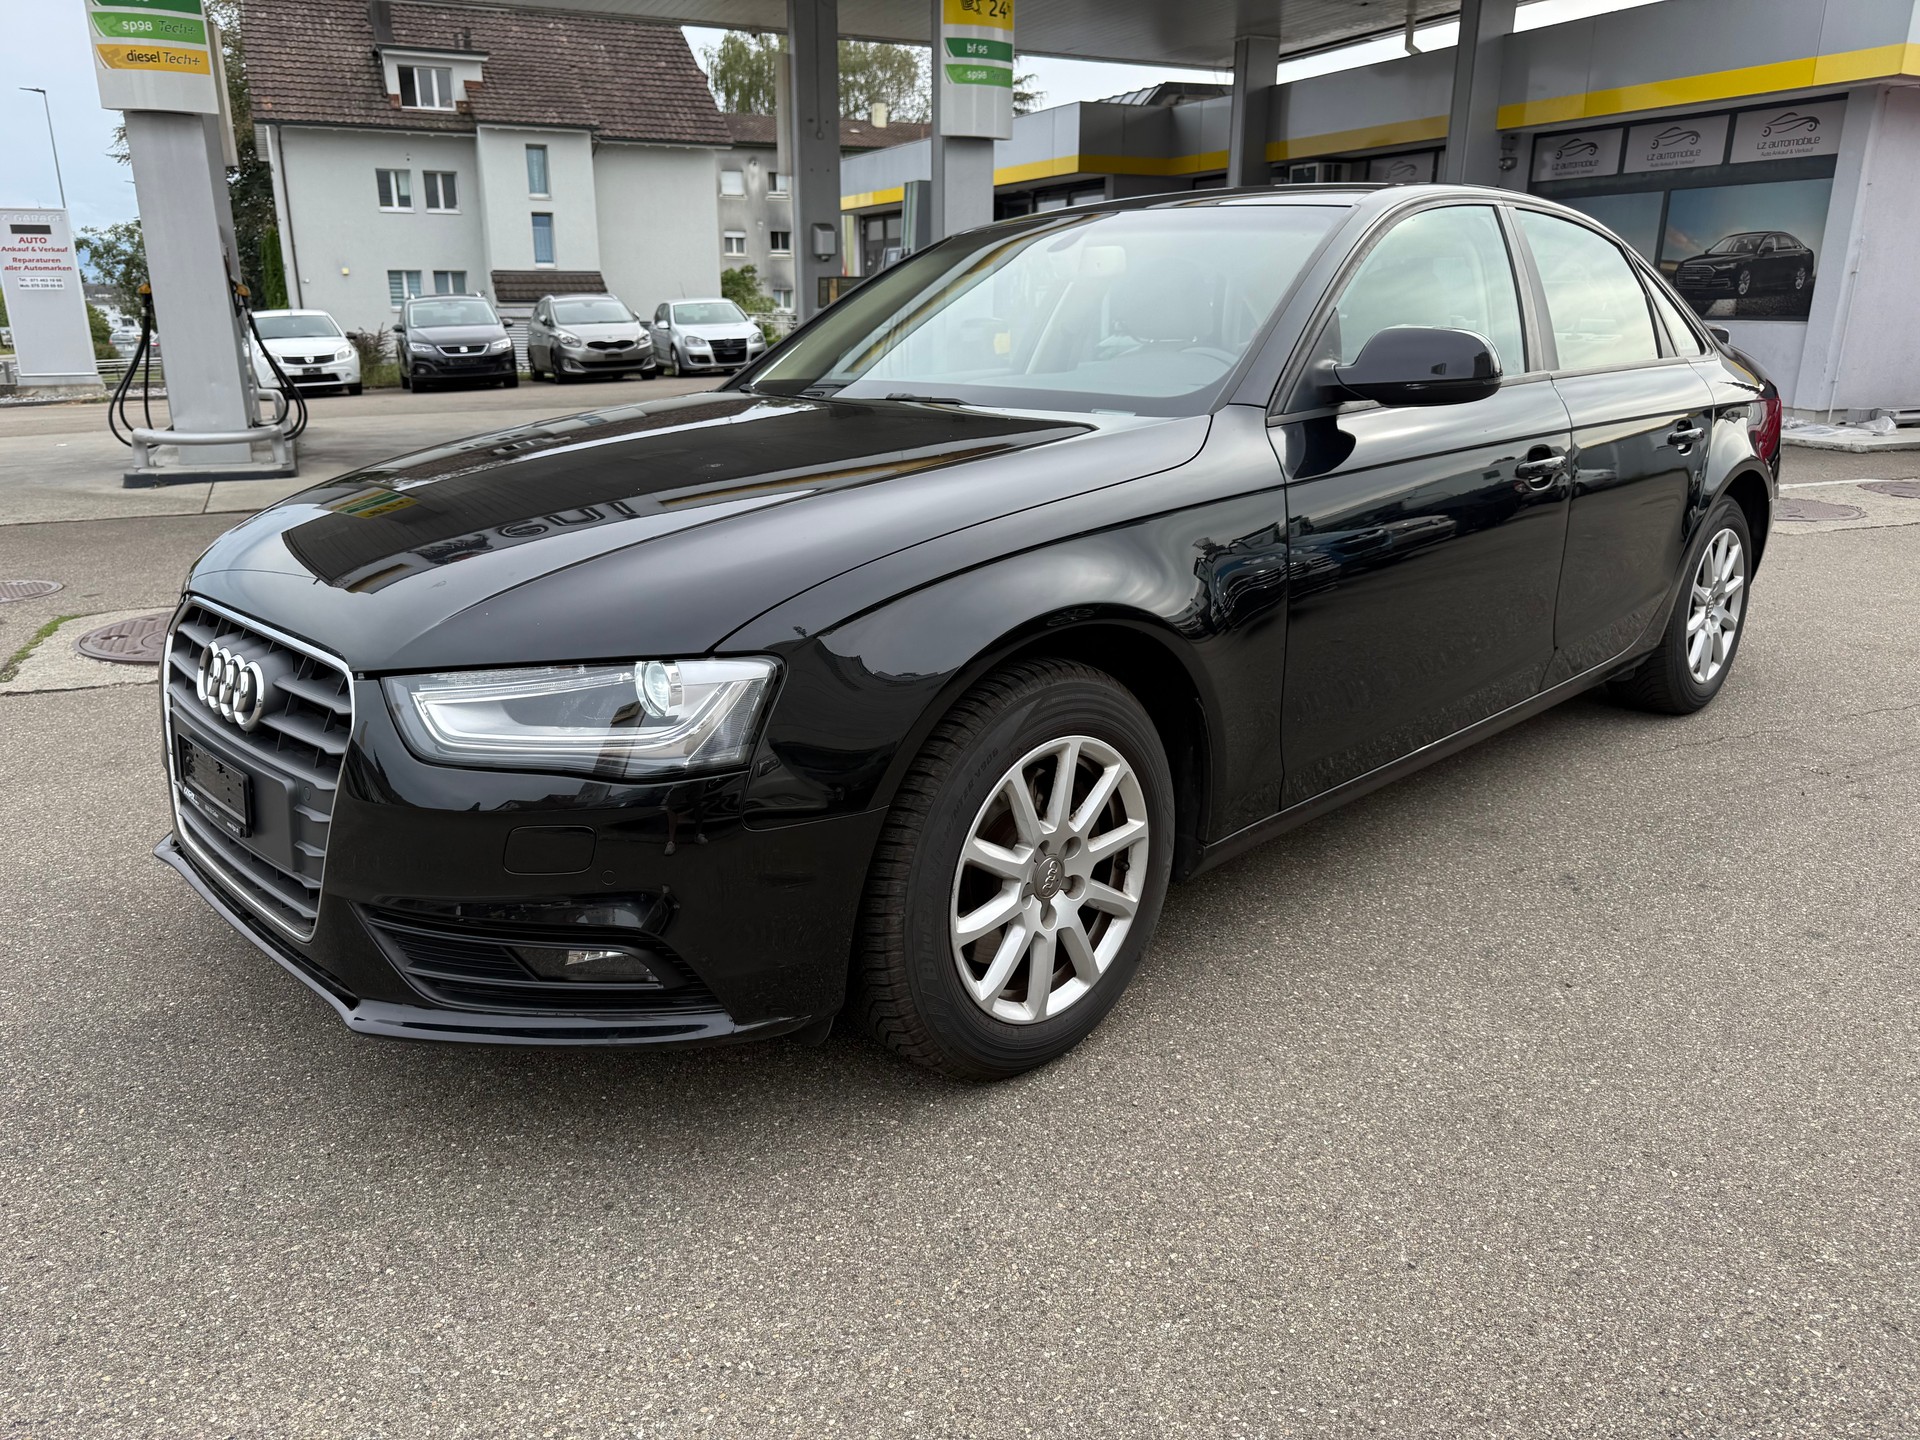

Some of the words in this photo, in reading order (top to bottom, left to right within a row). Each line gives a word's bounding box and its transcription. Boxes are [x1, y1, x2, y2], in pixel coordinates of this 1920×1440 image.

[122, 20, 153, 33] sp98
[158, 20, 196, 35] Tech+
[966, 43, 977, 53] bf
[977, 45, 988, 54] 95
[126, 49, 160, 63] diesel
[163, 51, 200, 66] Tech+
[1756, 142, 1767, 150] LZ
[18, 236, 47, 244] AUTO
[12, 257, 61, 265] Reparaturen
